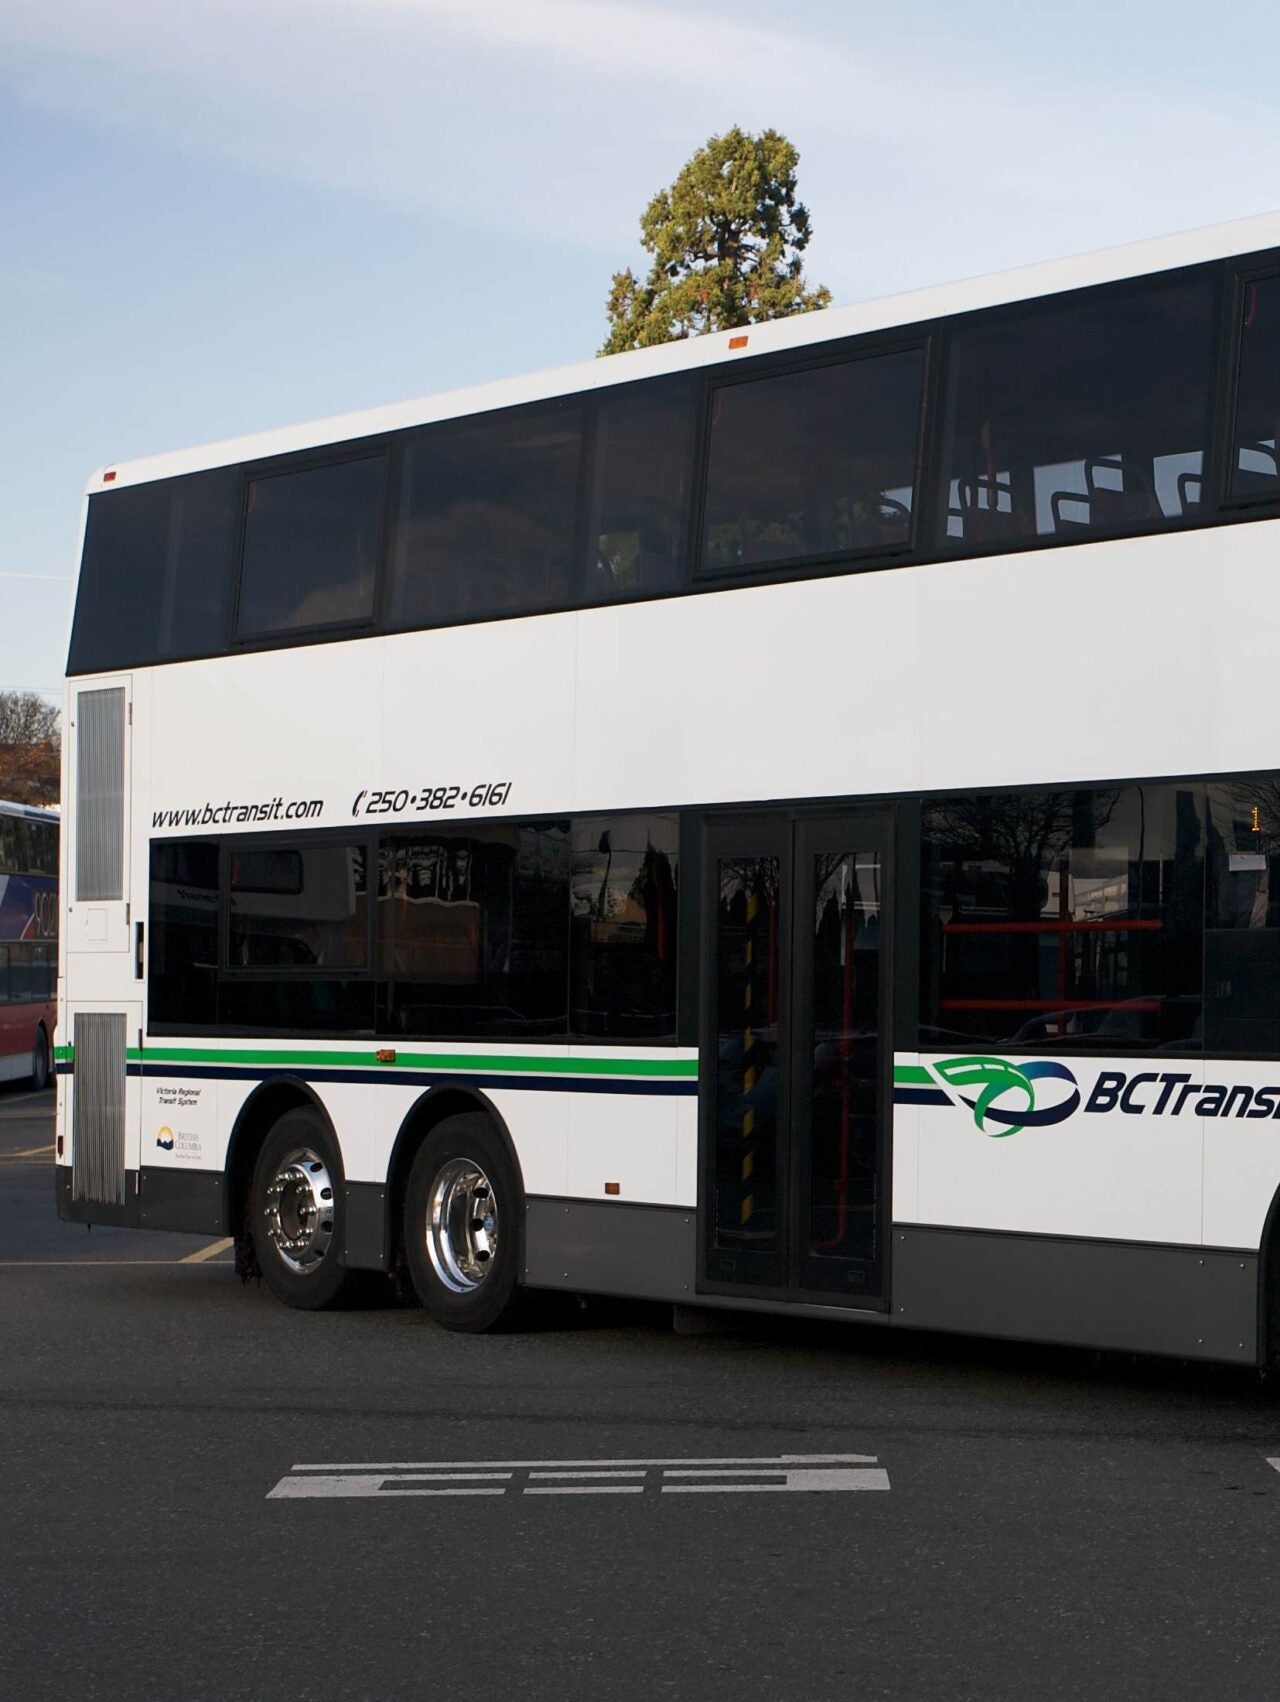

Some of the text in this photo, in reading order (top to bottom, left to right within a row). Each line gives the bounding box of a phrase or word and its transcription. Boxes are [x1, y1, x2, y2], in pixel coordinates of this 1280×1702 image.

[151, 797, 323, 828] www.bctransit.com
[1251, 806, 1260, 831] 1
[156, 1087, 202, 1097] Victoria Regional
[159, 1096, 197, 1107] Transit System
